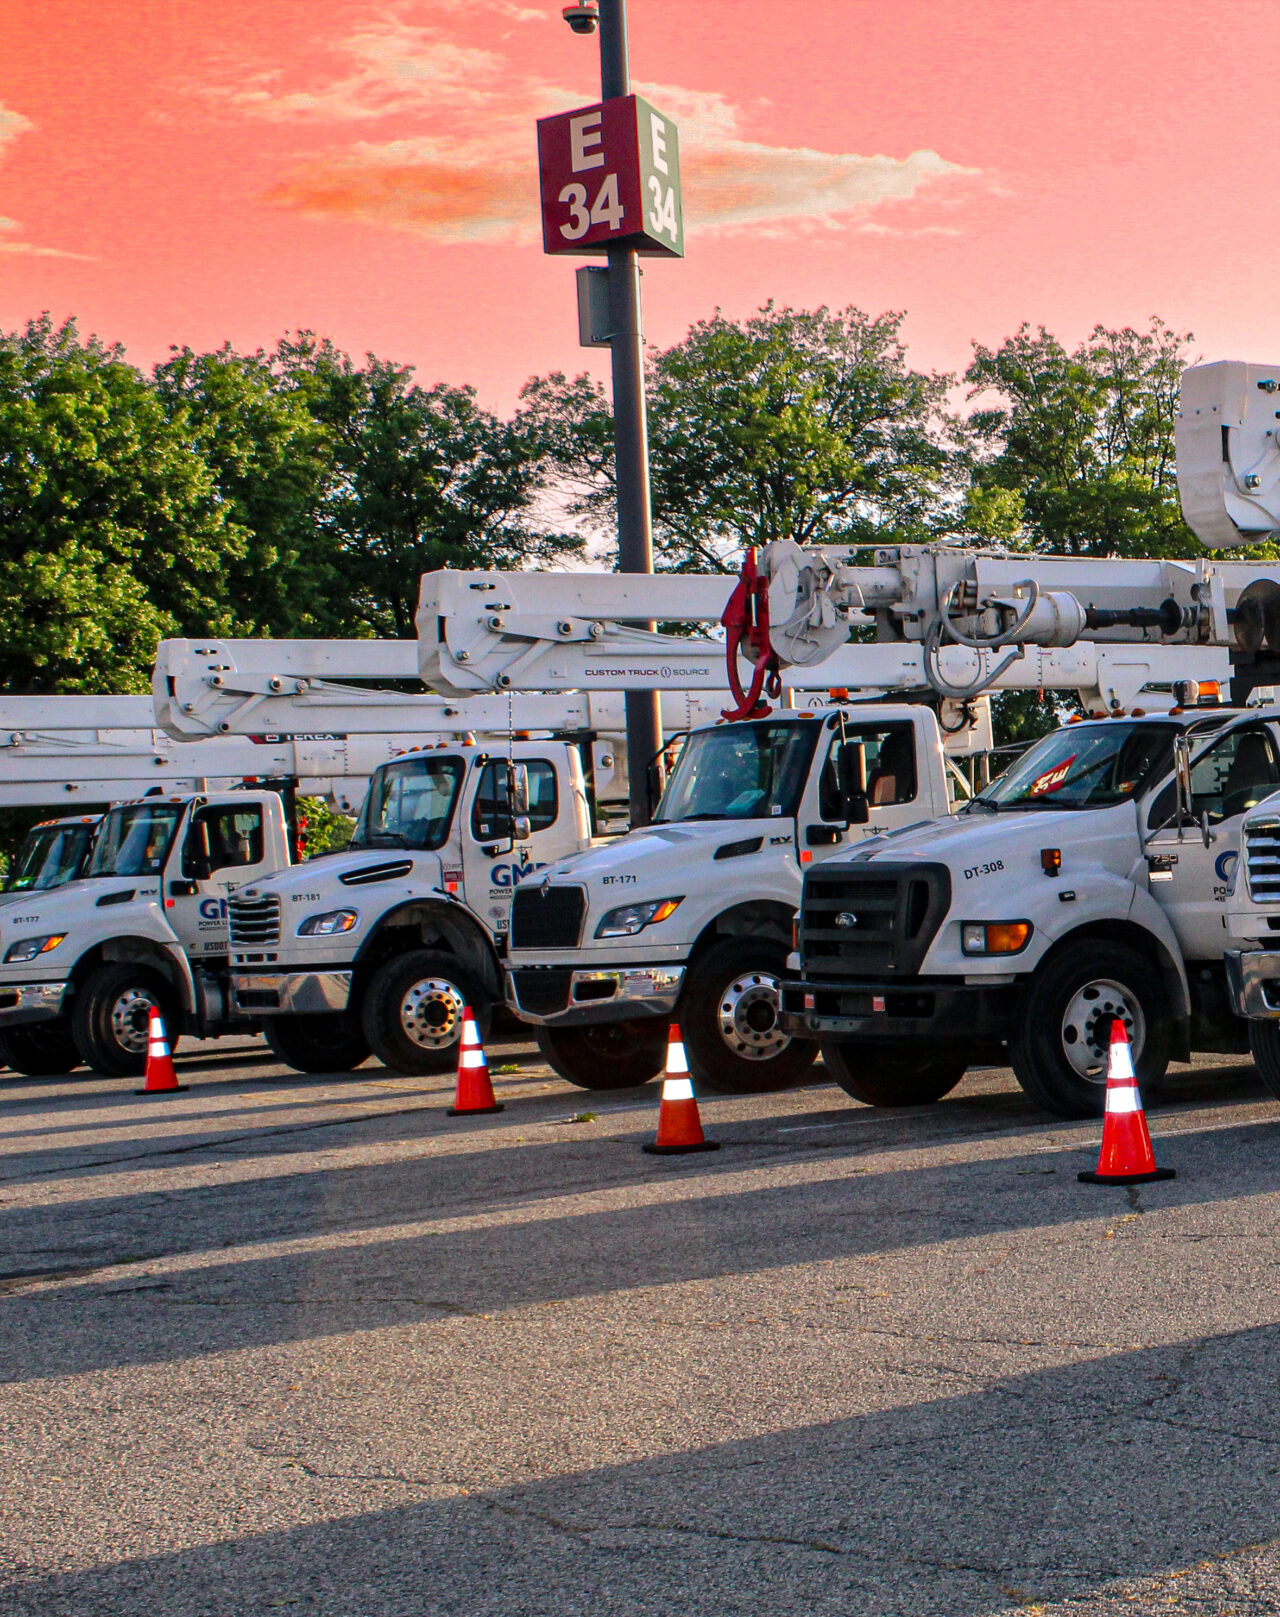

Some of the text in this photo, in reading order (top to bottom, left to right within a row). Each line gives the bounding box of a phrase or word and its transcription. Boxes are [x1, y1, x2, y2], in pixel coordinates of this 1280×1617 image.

[570, 111, 604, 173] E
[650, 113, 668, 175] E
[558, 173, 625, 240] 34
[648, 175, 677, 243] 34
[673, 668, 710, 676] SOURCE
[490, 863, 548, 887] GM
[602, 875, 637, 885] BT-171
[964, 860, 1005, 880] DT-308
[292, 894, 321, 902] BT-181
